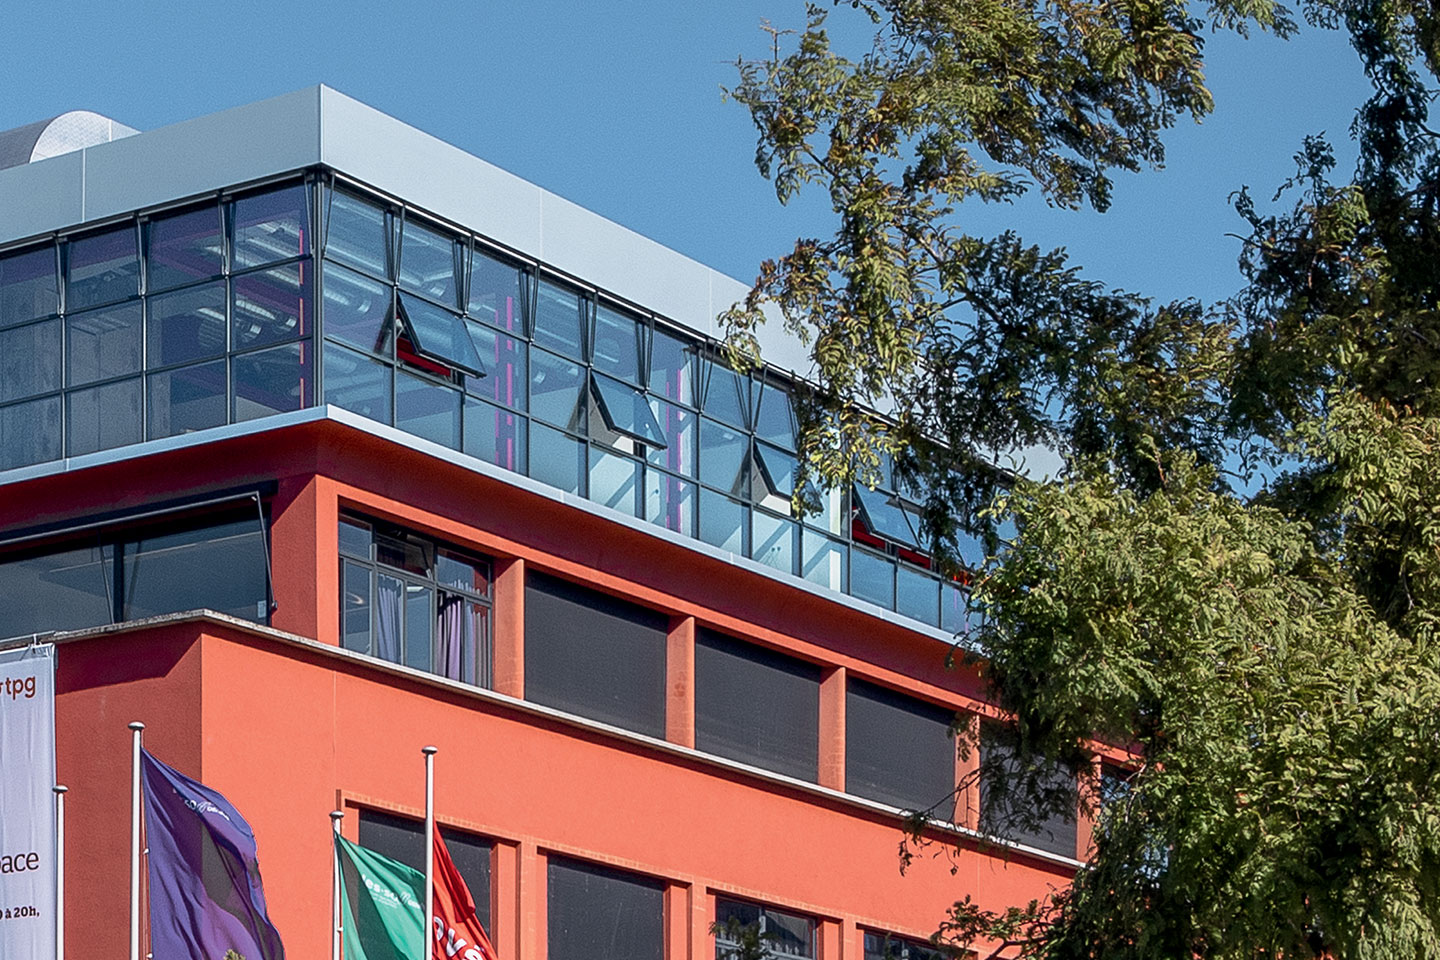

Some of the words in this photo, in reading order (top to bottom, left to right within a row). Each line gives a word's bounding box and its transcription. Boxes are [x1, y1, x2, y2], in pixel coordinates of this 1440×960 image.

[5, 676, 36, 701] tpg
[4, 908, 12, 919] à
[13, 906, 40, 918] 20h,
